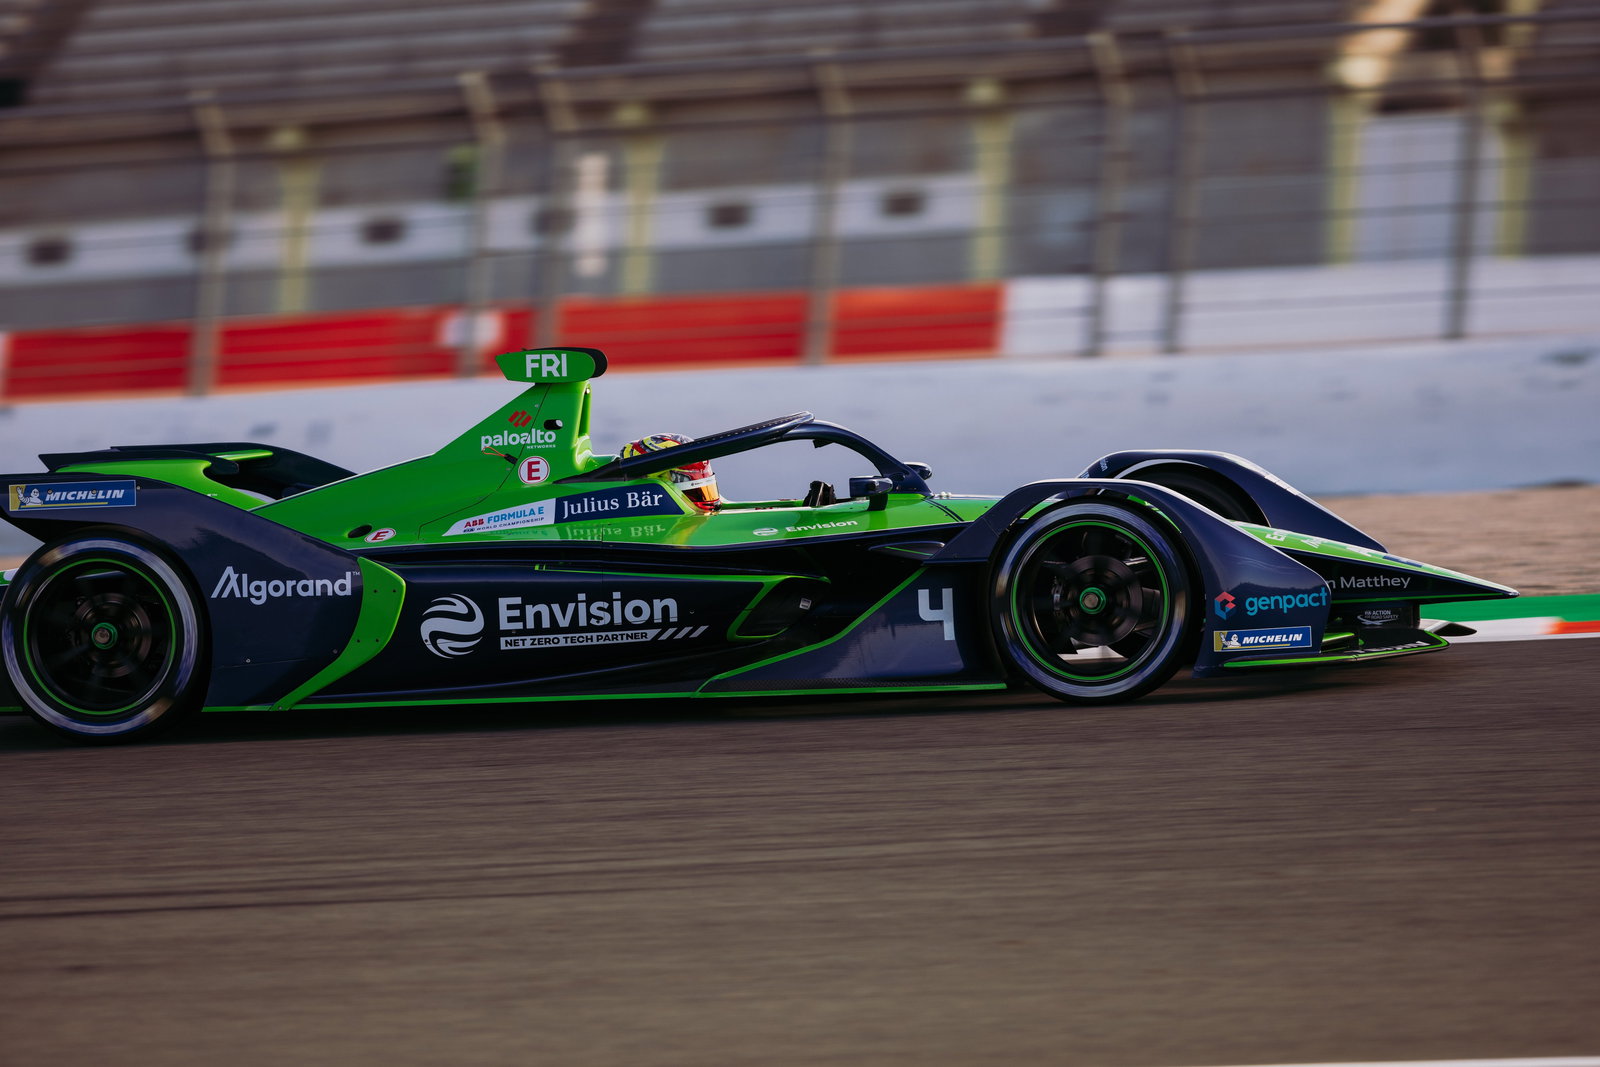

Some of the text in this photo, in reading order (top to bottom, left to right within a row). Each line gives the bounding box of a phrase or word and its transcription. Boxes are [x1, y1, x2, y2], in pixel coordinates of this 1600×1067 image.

[525, 353, 568, 378] FRI
[481, 428, 557, 452] paloalto
[527, 460, 541, 481] E
[46, 489, 125, 502] MICHELIN
[563, 491, 663, 519] Julius Bär
[464, 506, 545, 529] ABB FORMULA E
[499, 517, 545, 528] CHAMPIONSHIP
[785, 520, 859, 533] Envision
[371, 530, 389, 541] E
[1340, 574, 1411, 589] Matthey
[498, 591, 678, 631] Envision
[1245, 587, 1328, 616] genpact
[917, 587, 956, 641] 4
[504, 631, 649, 648] NET ZERO TECH PARTNER
[1242, 633, 1303, 645] MICHELIN
